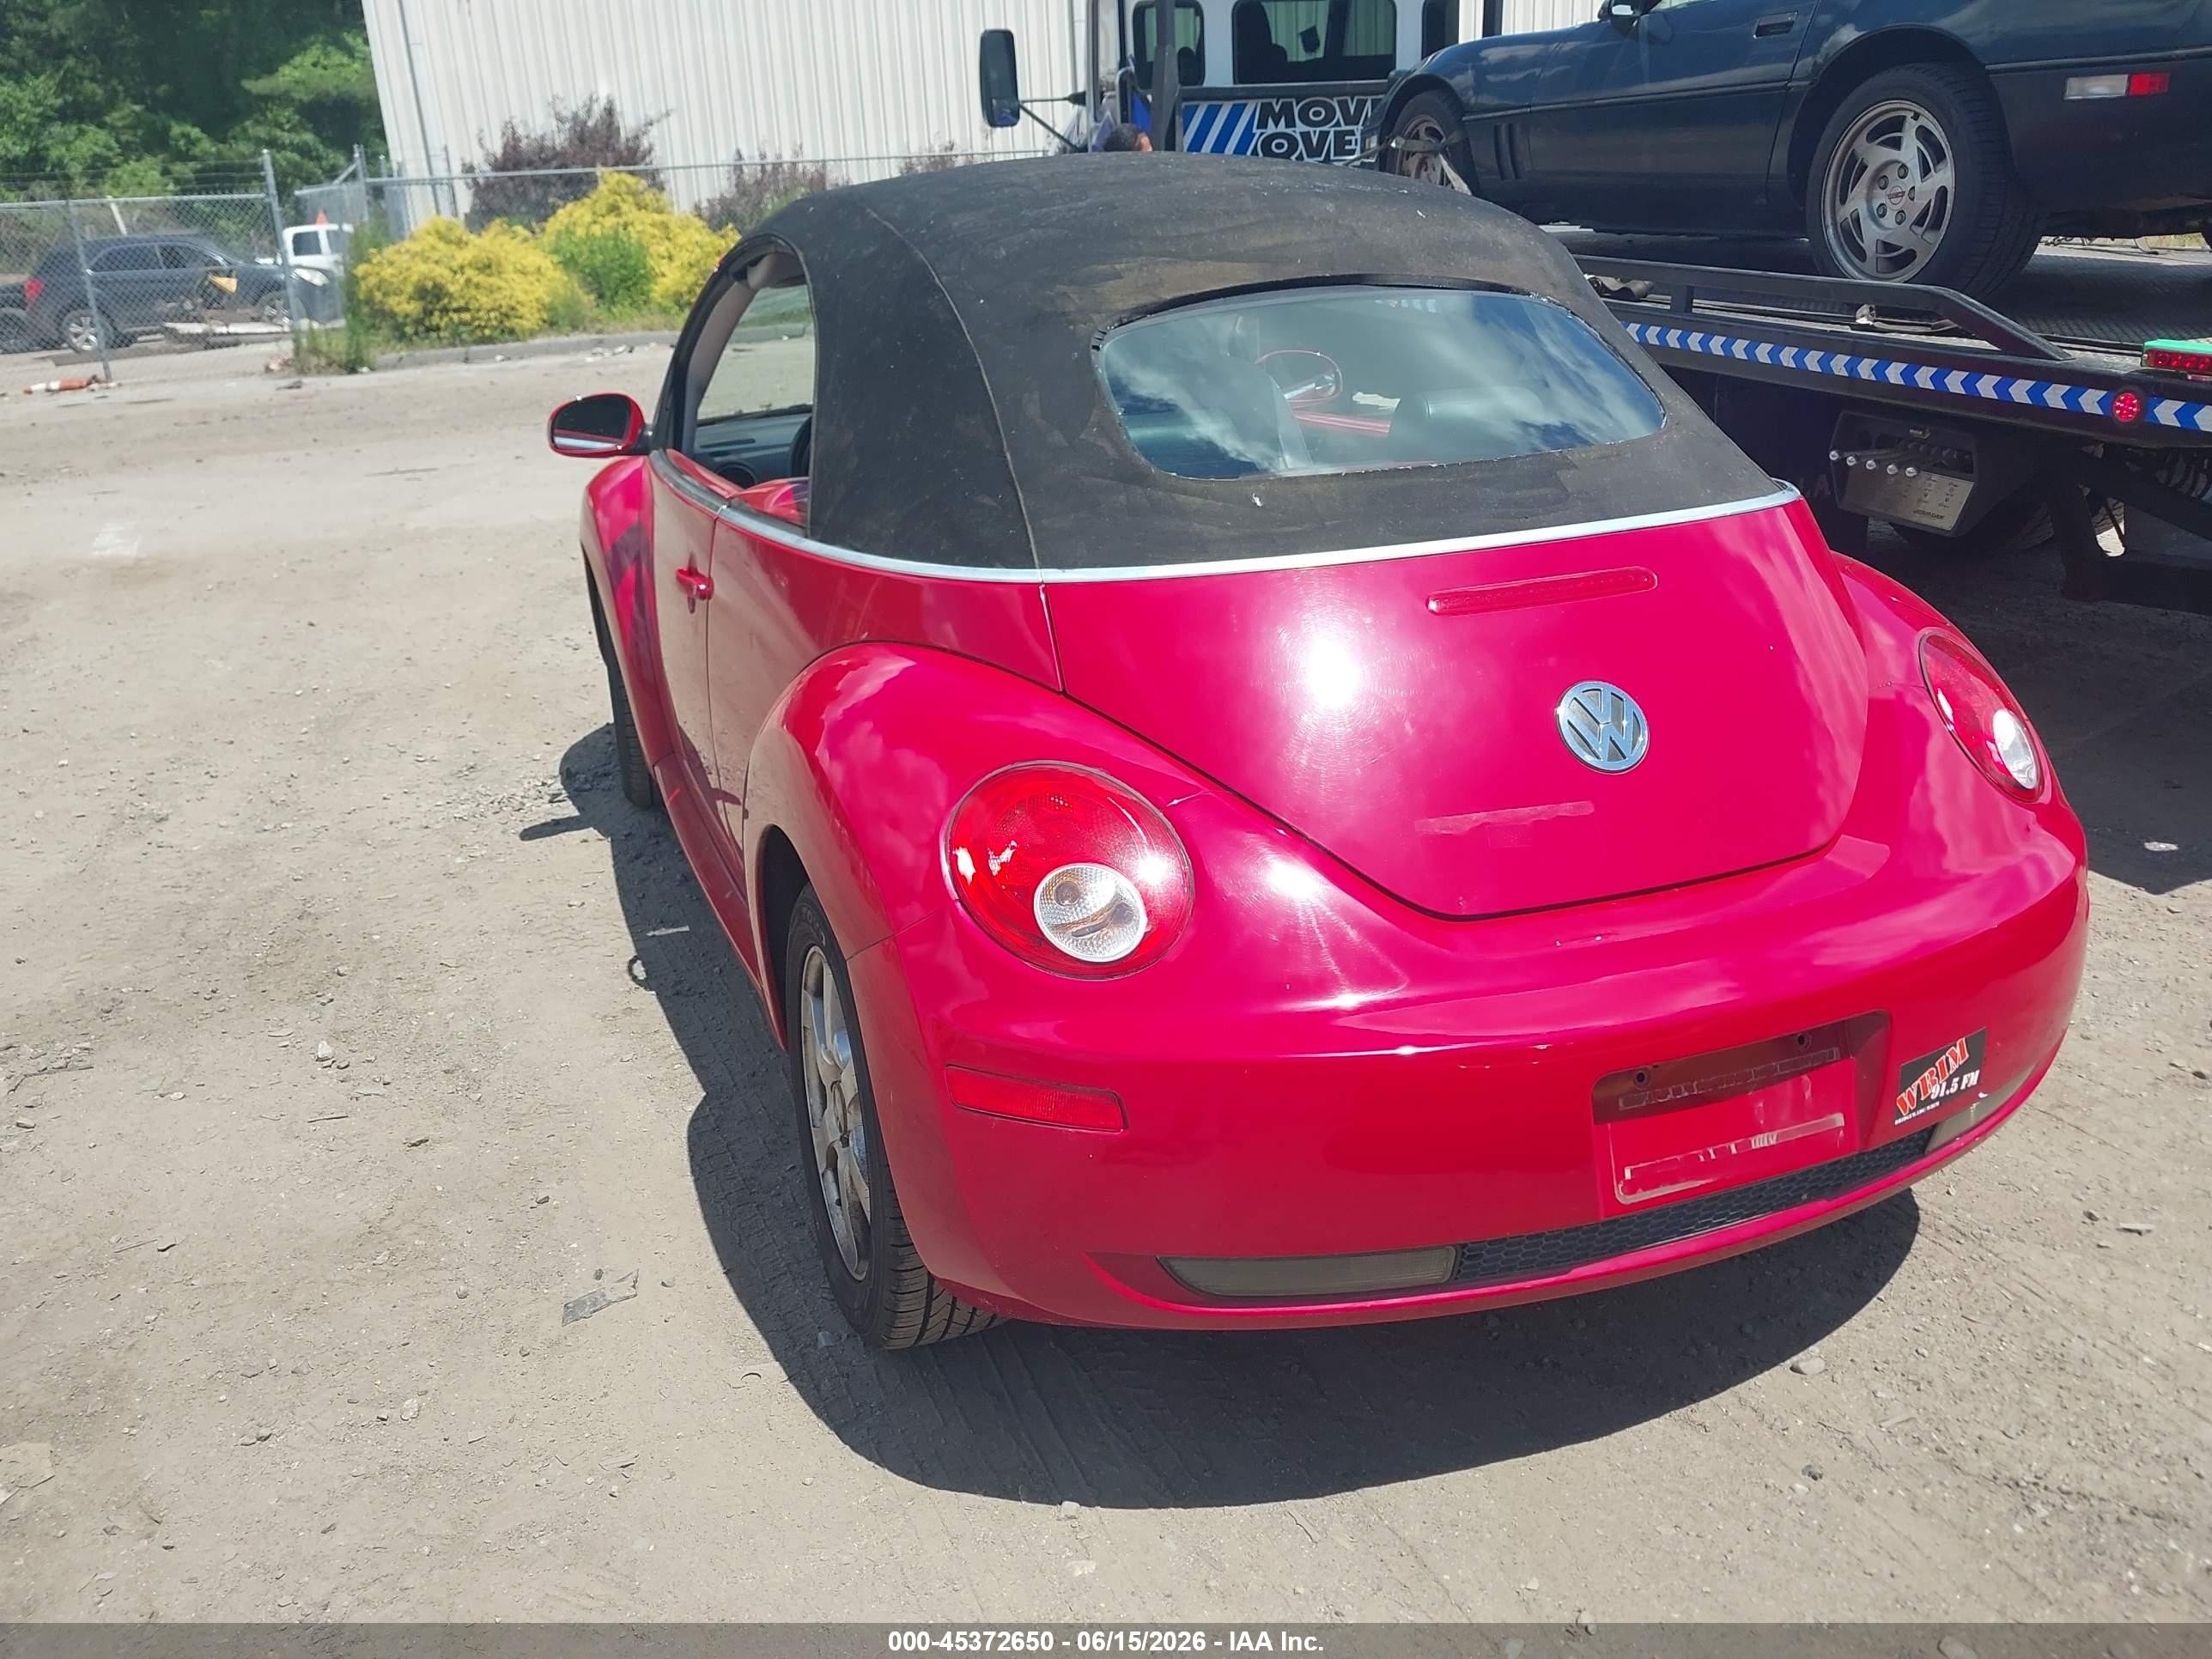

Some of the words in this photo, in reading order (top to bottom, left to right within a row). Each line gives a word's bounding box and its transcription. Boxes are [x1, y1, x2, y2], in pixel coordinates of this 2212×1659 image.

[1257, 130, 1372, 163] OVE
[1930, 1077, 1960, 1099] 91.5
[1960, 1069, 1980, 1090] FM
